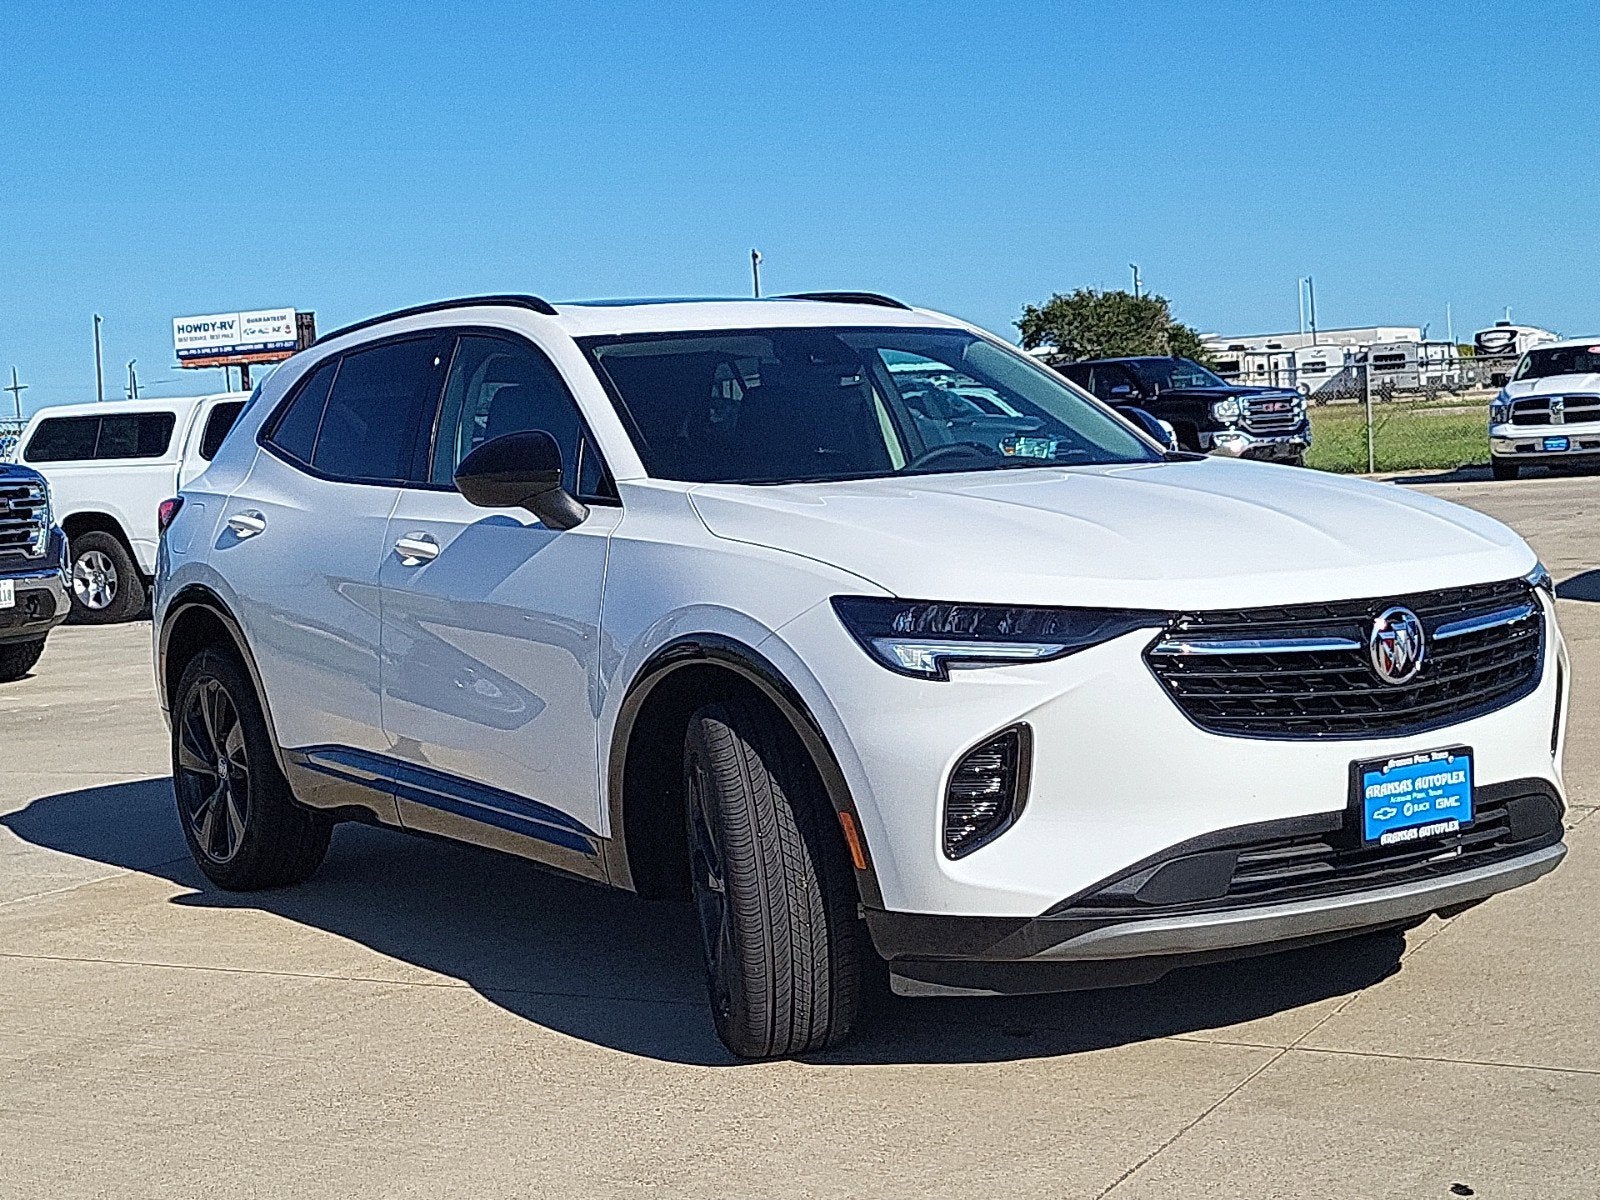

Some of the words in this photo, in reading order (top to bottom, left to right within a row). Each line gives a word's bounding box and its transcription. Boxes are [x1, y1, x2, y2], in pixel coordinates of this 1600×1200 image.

[177, 319, 236, 334] HOWDY-RV
[1365, 778, 1413, 799] ARANSAS
[1414, 770, 1466, 790] AUTOPLEX
[1435, 795, 1461, 809] GMC
[1380, 827, 1418, 846] ARANSAS
[1418, 819, 1460, 838] AUTOPLEX
